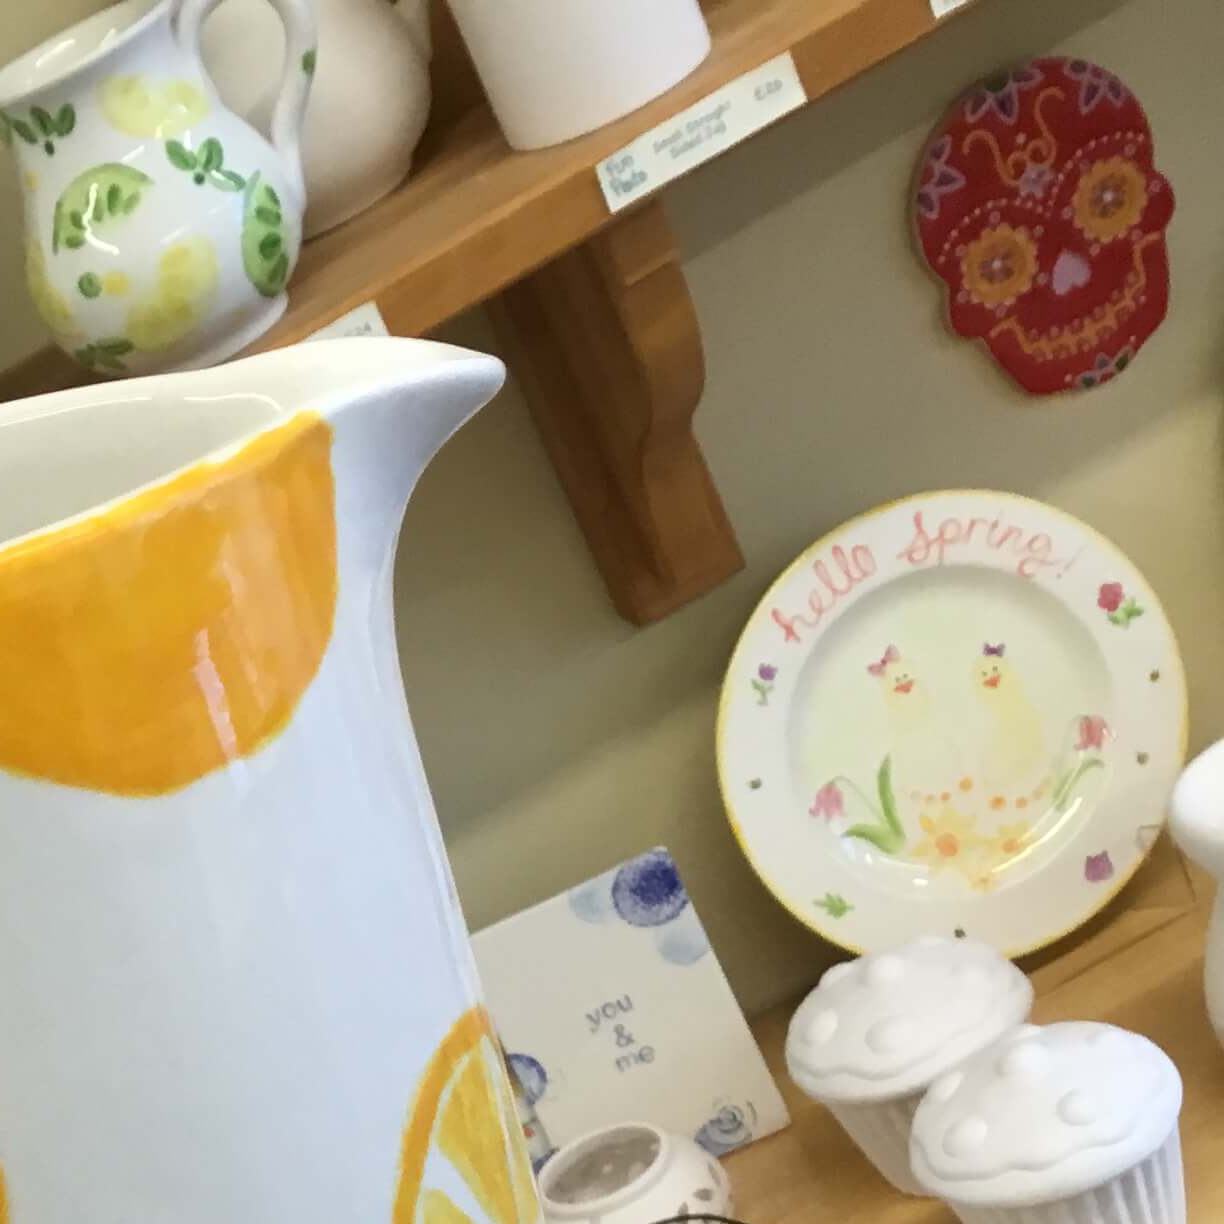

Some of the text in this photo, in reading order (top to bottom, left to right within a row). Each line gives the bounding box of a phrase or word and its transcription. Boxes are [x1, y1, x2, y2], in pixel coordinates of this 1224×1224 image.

[771, 543, 878, 643] hello
[584, 993, 633, 1034] you
[613, 1023, 635, 1048] &
[615, 1045, 656, 1074] me
